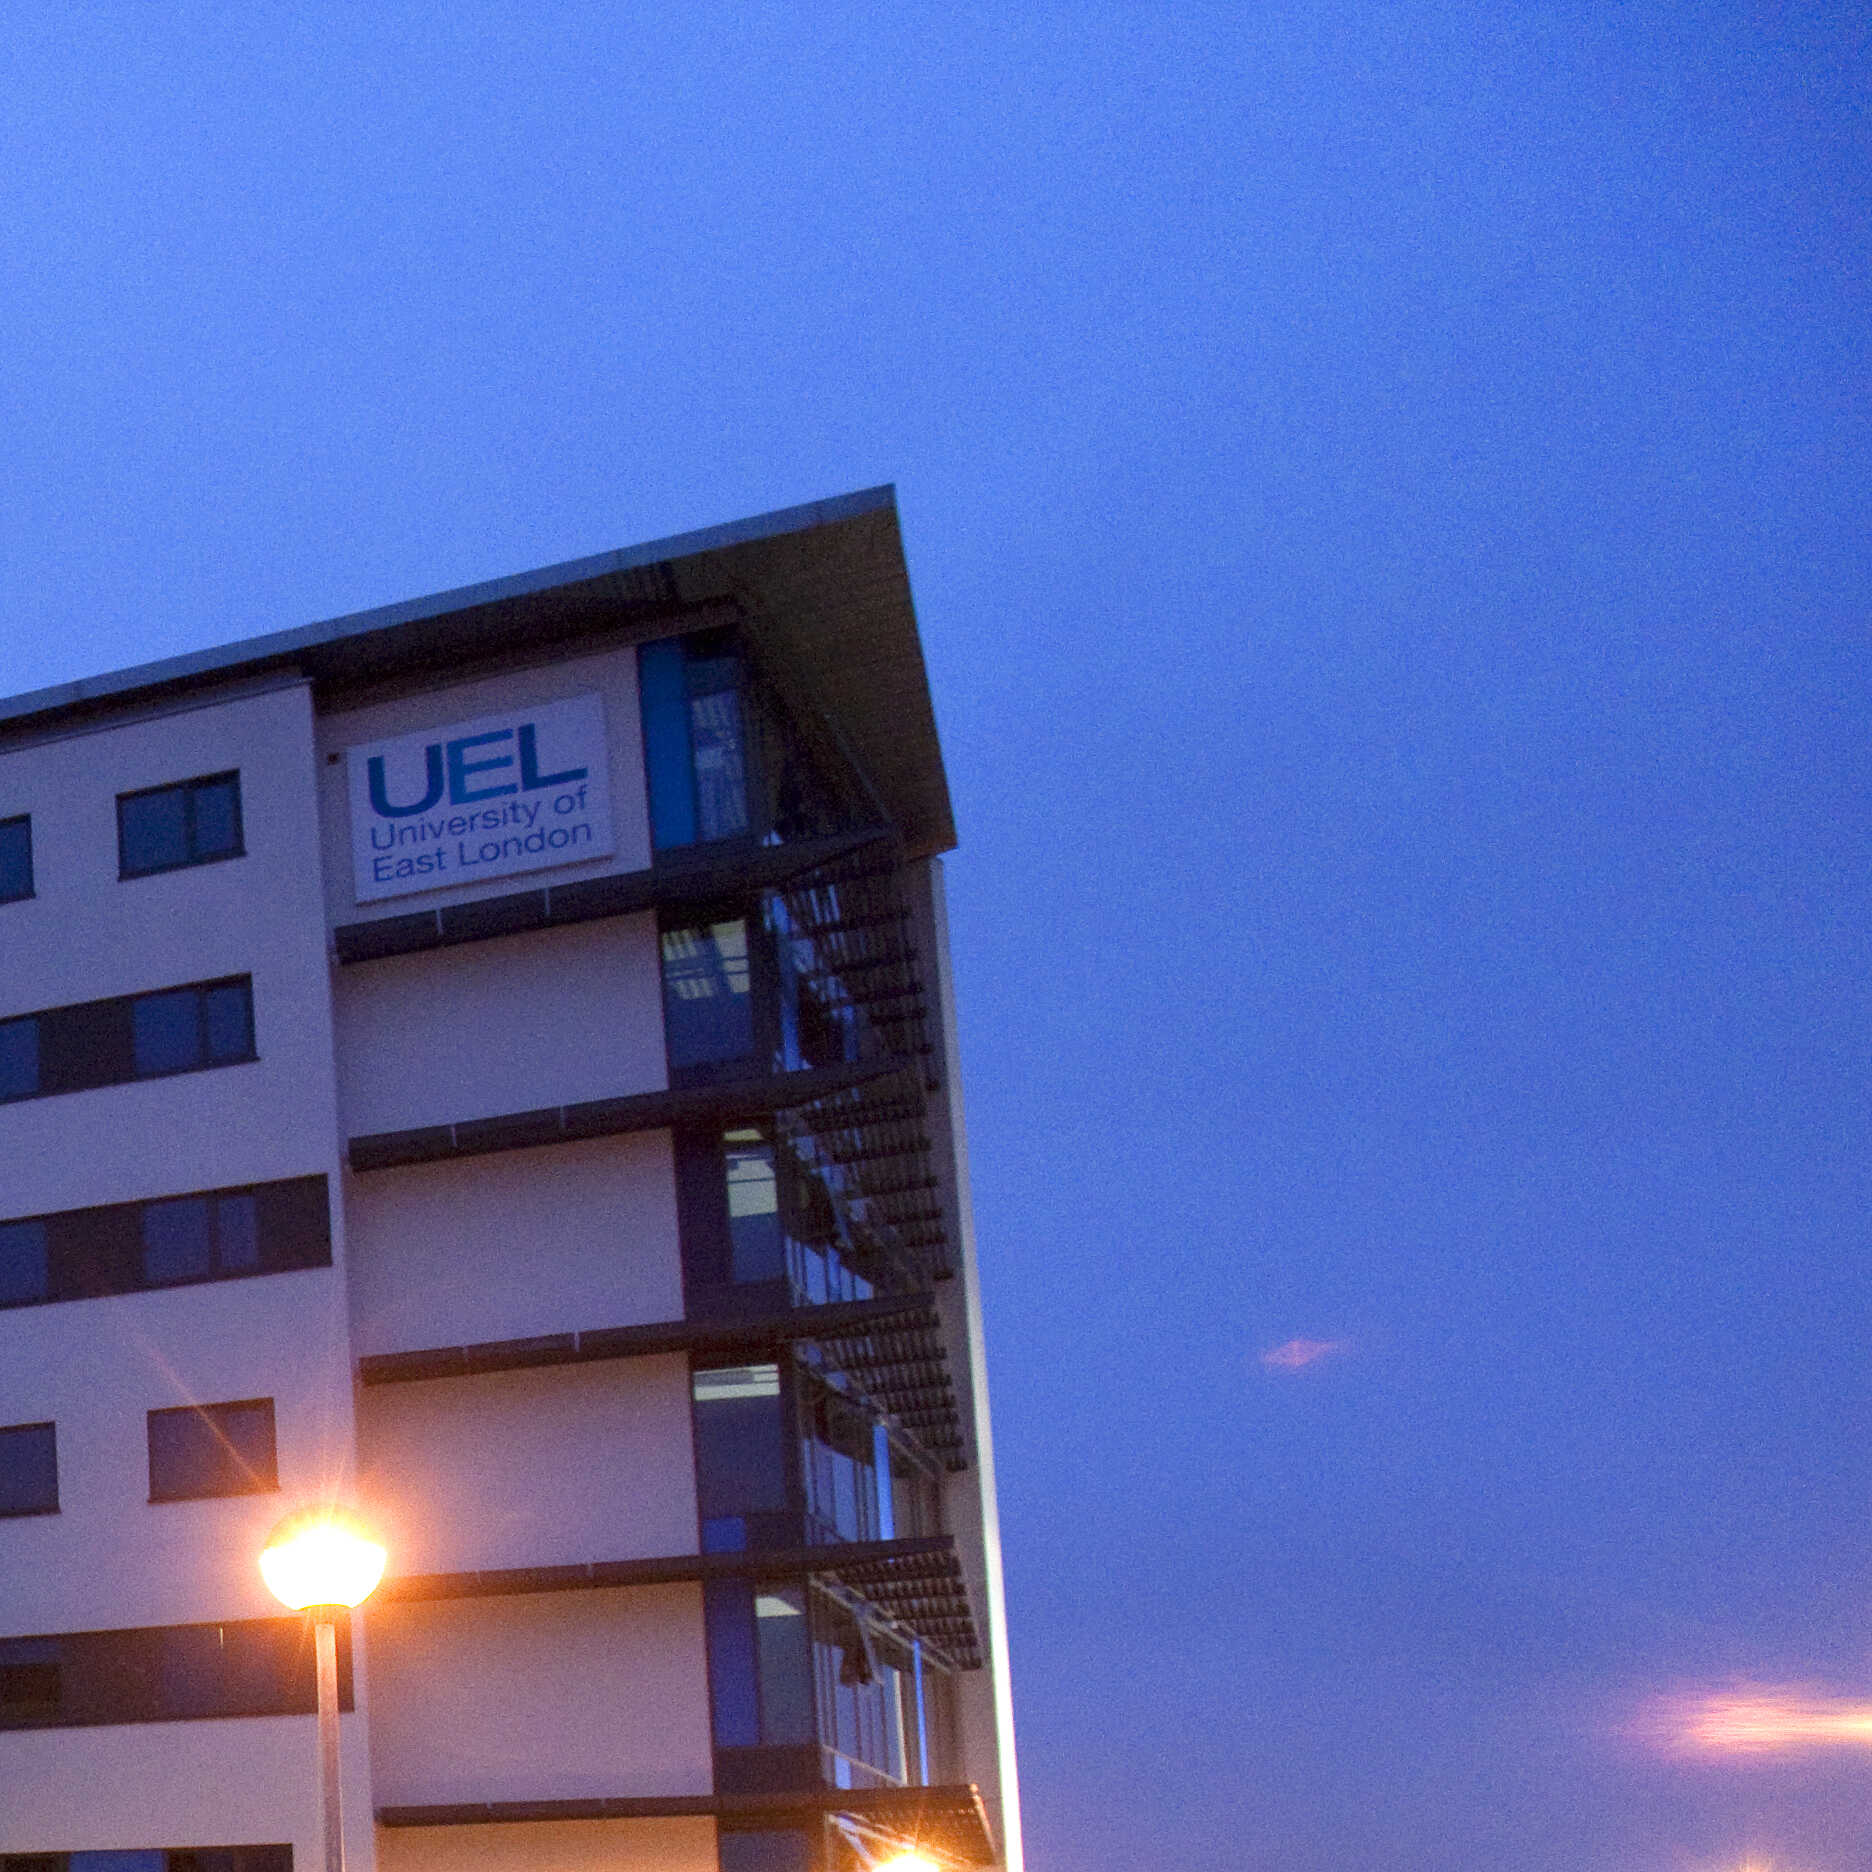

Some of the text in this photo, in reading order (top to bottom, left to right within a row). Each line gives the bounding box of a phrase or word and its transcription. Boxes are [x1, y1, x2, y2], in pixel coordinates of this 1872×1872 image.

[367, 723, 588, 818] UEL
[371, 784, 588, 850] University of
[373, 823, 592, 882] East London
